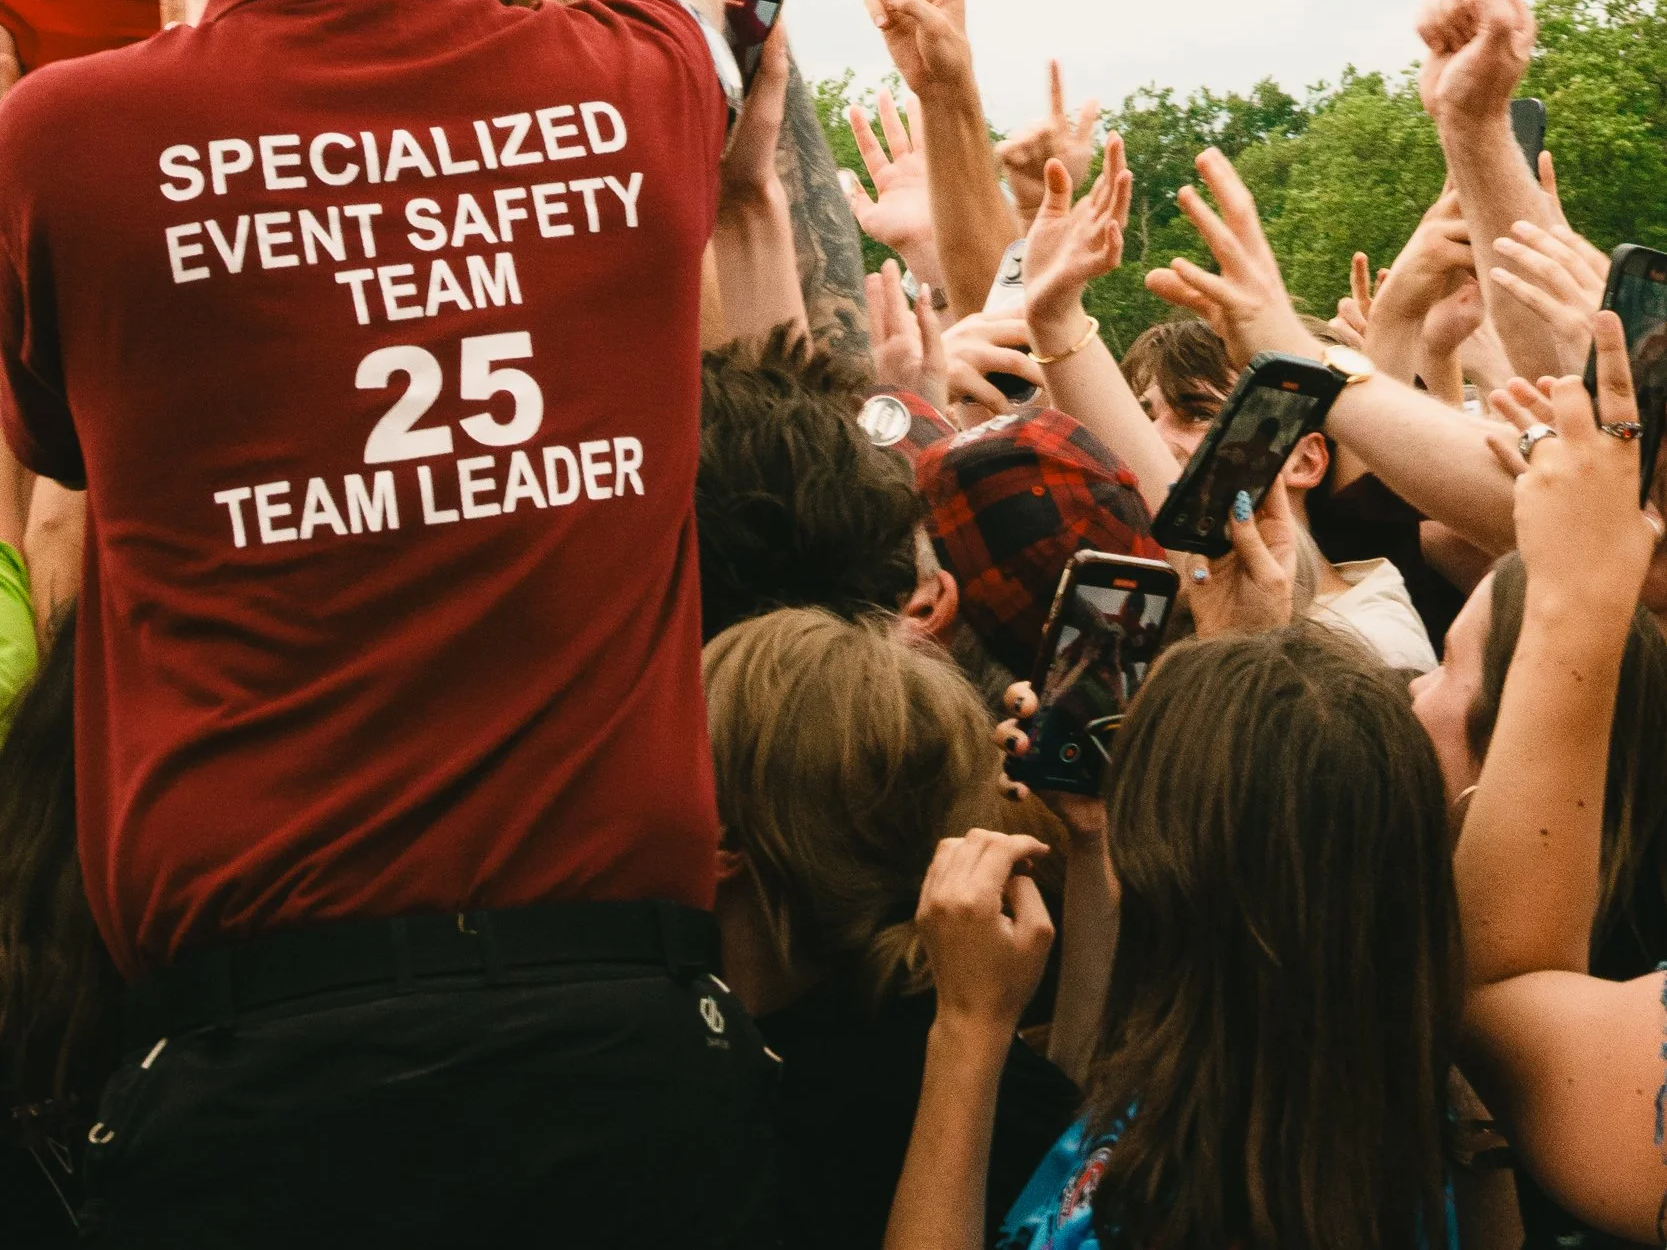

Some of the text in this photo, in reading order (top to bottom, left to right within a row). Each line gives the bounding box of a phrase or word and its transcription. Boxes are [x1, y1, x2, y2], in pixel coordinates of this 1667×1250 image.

[159, 100, 629, 202] SPECIALIZED
[165, 172, 644, 284] EVENT SAFETY
[334, 251, 523, 325] TEAM
[354, 331, 544, 464] 25
[213, 436, 645, 548] TEAM LEADER
